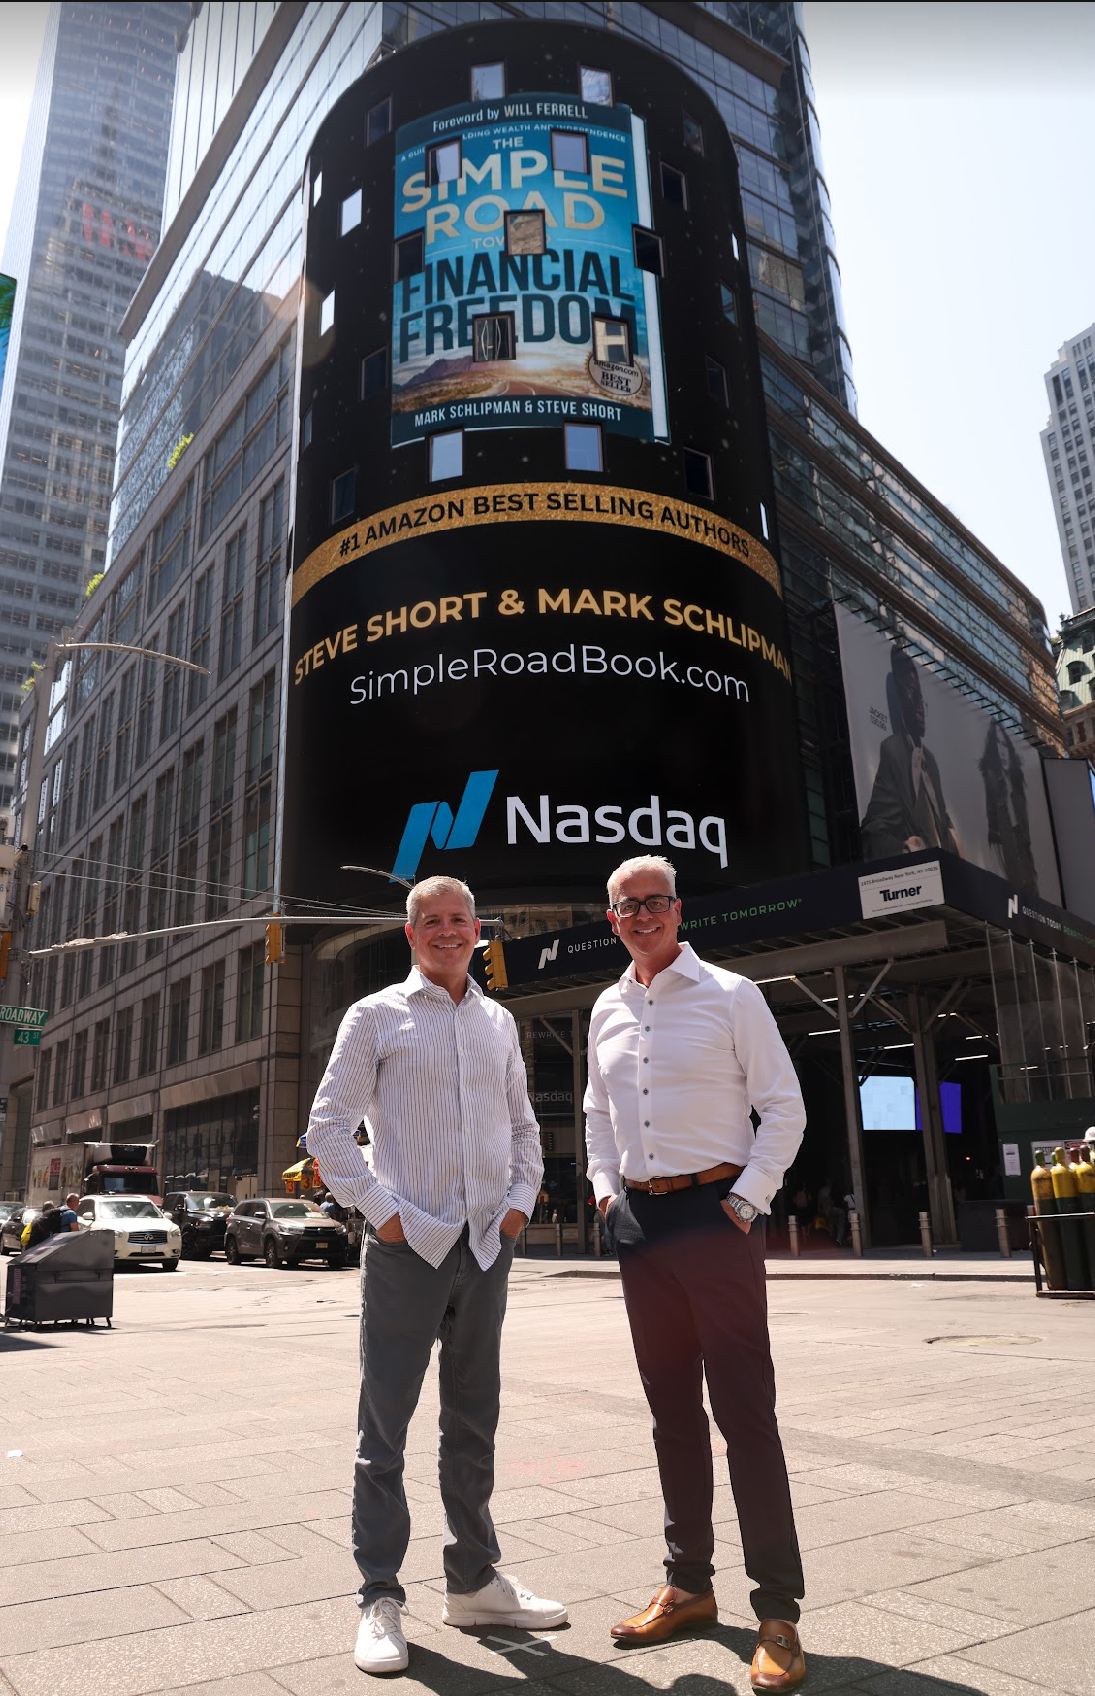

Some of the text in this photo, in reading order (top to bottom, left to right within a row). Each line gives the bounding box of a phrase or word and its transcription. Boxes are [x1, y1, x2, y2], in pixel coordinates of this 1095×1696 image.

[432, 102, 588, 133] Foreword by WILL FERRELL
[461, 129, 491, 140] LDING
[493, 123, 531, 135] WEALTH
[493, 136, 524, 151] THE
[425, 190, 605, 245] ROAD
[402, 248, 636, 314] FINANCIAL
[414, 400, 622, 427] MARK SCHLIPMAN & STEVE SHORT
[339, 492, 750, 558] #1 AMAZON BEST SELLING AUTHORS
[294, 588, 793, 687] STEVE SHORT & MARK SCHLIPMAN
[350, 643, 750, 705] SimpleRoadBook.com
[506, 794, 729, 870] Nasdaq
[879, 885, 922, 902] Turner
[1022, 905, 1047, 924] QUESTION
[567, 937, 617, 954] QUESTION
[677, 915, 717, 932] WRITE
[0, 1006, 45, 1025] ROADWAY
[18, 1031, 39, 1044] 43 ST
